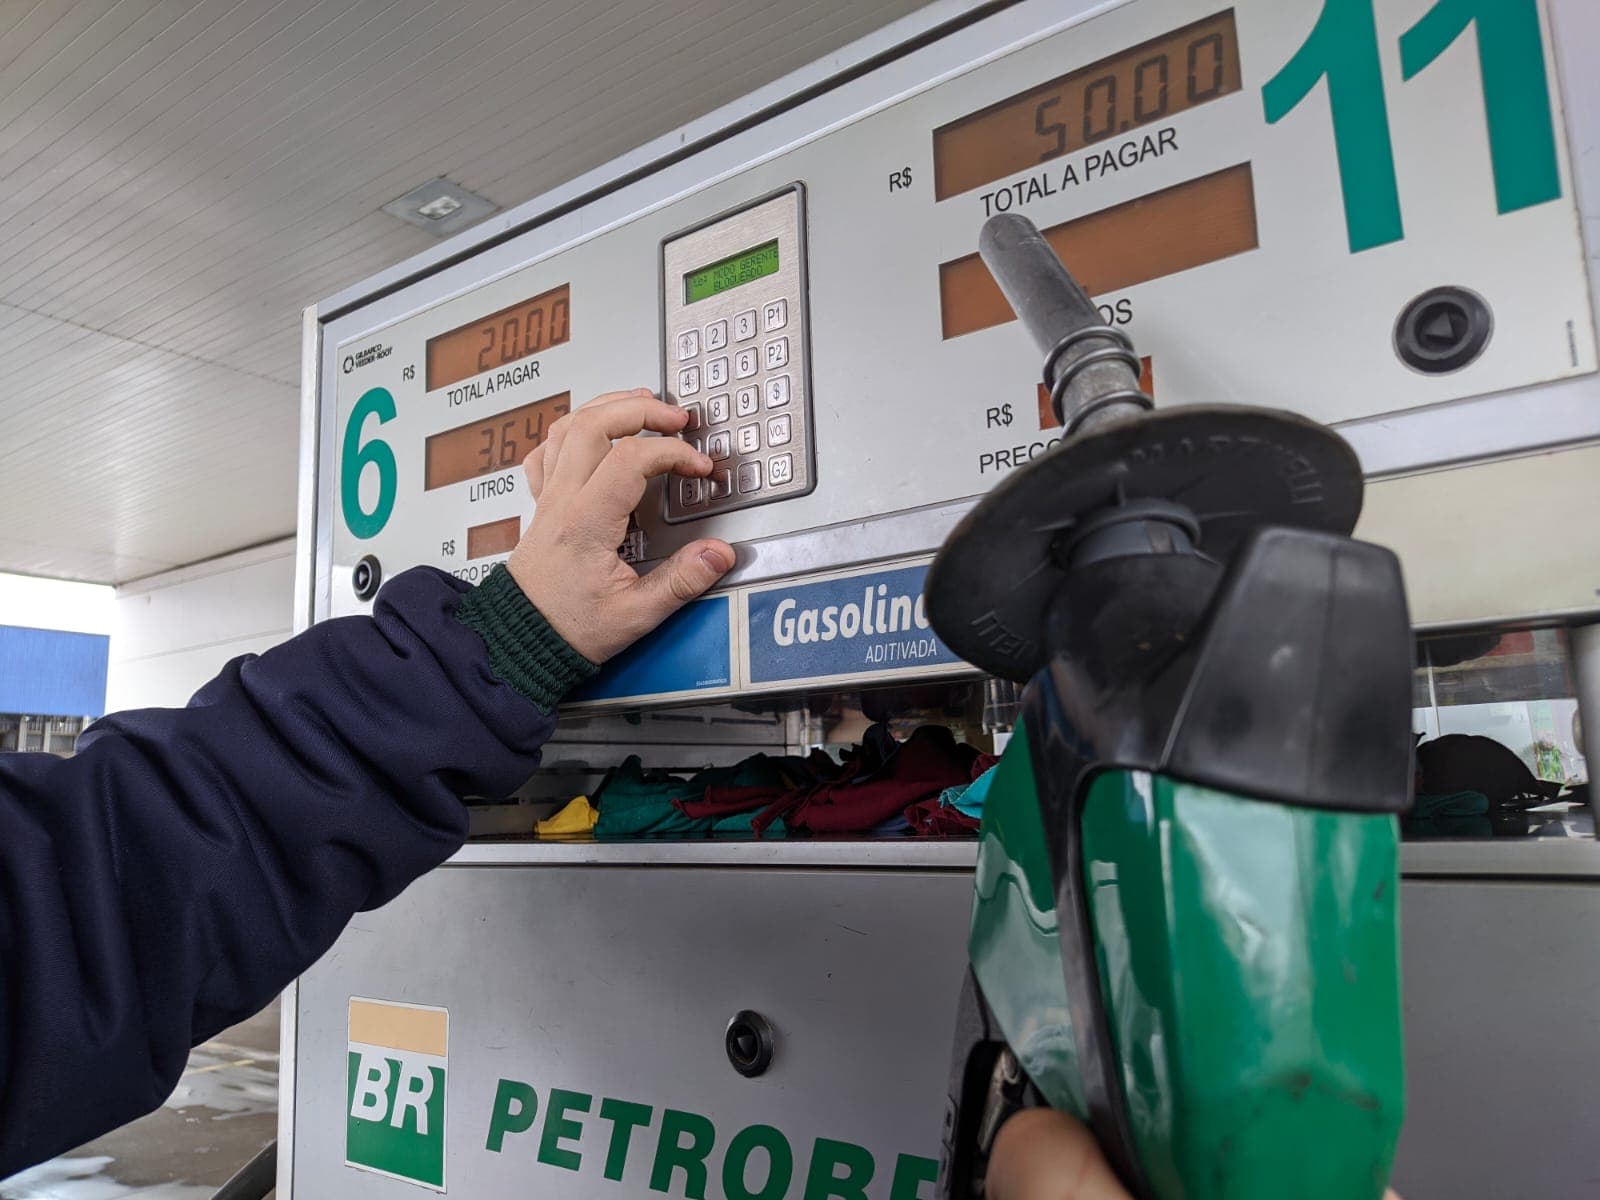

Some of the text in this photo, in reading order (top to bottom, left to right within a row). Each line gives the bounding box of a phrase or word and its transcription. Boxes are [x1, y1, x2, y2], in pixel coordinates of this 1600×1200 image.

[1035, 33, 1223, 162] 50.00
[1262, 0, 1562, 254] 11
[888, 167, 913, 192] R$
[980, 127, 1179, 217] TOTAL A PAGAR
[767, 306, 781, 325] P1
[477, 301, 570, 372] 20.00
[711, 327, 719, 346] 2
[740, 318, 748, 335] 3
[740, 355, 749, 372] 6
[768, 344, 783, 364] P2
[402, 364, 416, 382] R$
[712, 364, 720, 381] 5
[447, 360, 541, 408] TOTAL A PAGAR
[713, 401, 721, 417] 8
[742, 393, 750, 410] 9
[985, 402, 1014, 428] R$
[479, 404, 570, 472] 3.64
[744, 430, 751, 448] E
[769, 423, 786, 438] VOL
[341, 387, 398, 540] 6
[771, 460, 787, 478] G2
[470, 474, 515, 502] LITROS
[441, 540, 456, 557] R$
[864, 638, 937, 664] ADITIVADA
[349, 1050, 434, 1135] BR
